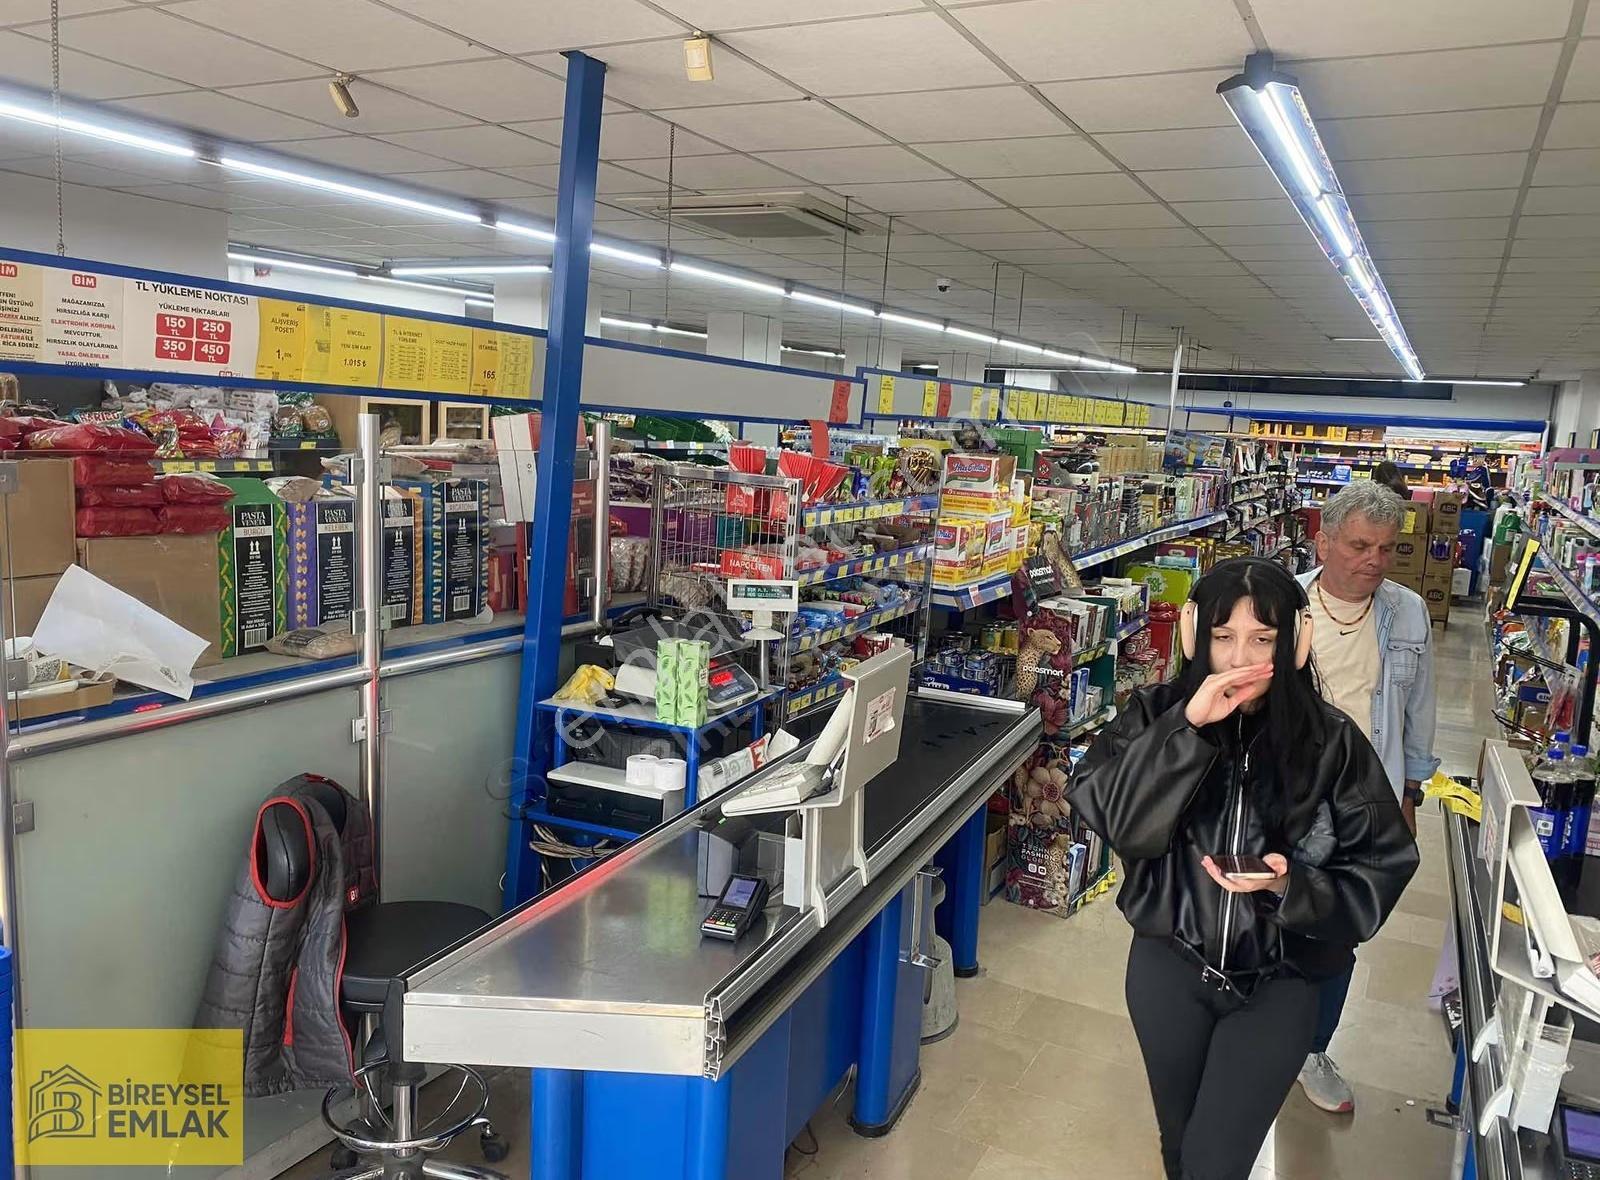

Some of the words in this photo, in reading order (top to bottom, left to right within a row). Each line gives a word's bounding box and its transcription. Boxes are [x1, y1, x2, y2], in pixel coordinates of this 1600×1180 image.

[0, 265, 15, 276] İM
[74, 275, 95, 287] BİM
[136, 281, 149, 291] TL
[151, 283, 202, 299] YÜKLEME
[204, 291, 249, 305] NOKTASI
[62, 297, 105, 308] MAĞAZAMIZDA
[56, 308, 91, 317] HIRSIZLIĞA
[91, 312, 110, 320] KARŞI
[158, 303, 190, 313] YÜKLEME
[191, 307, 230, 318] MİKTARLARI
[51, 318, 89, 328] ELEKTRONİK
[164, 316, 186, 329] 150
[202, 322, 225, 333] 250
[271, 318, 299, 328] ALIŞVERİŞ
[46, 338, 77, 346] HIRSIZLIK
[78, 340, 118, 350] OLAYLARINDA
[162, 340, 187, 352] 350
[78, 351, 110, 359] ÖNLEMLER
[200, 344, 225, 356] 450
[452, 487, 472, 496] PASTA
[241, 511, 266, 520] PASTA
[324, 509, 346, 517] PASTA
[1023, 665, 1064, 677] polosmart
